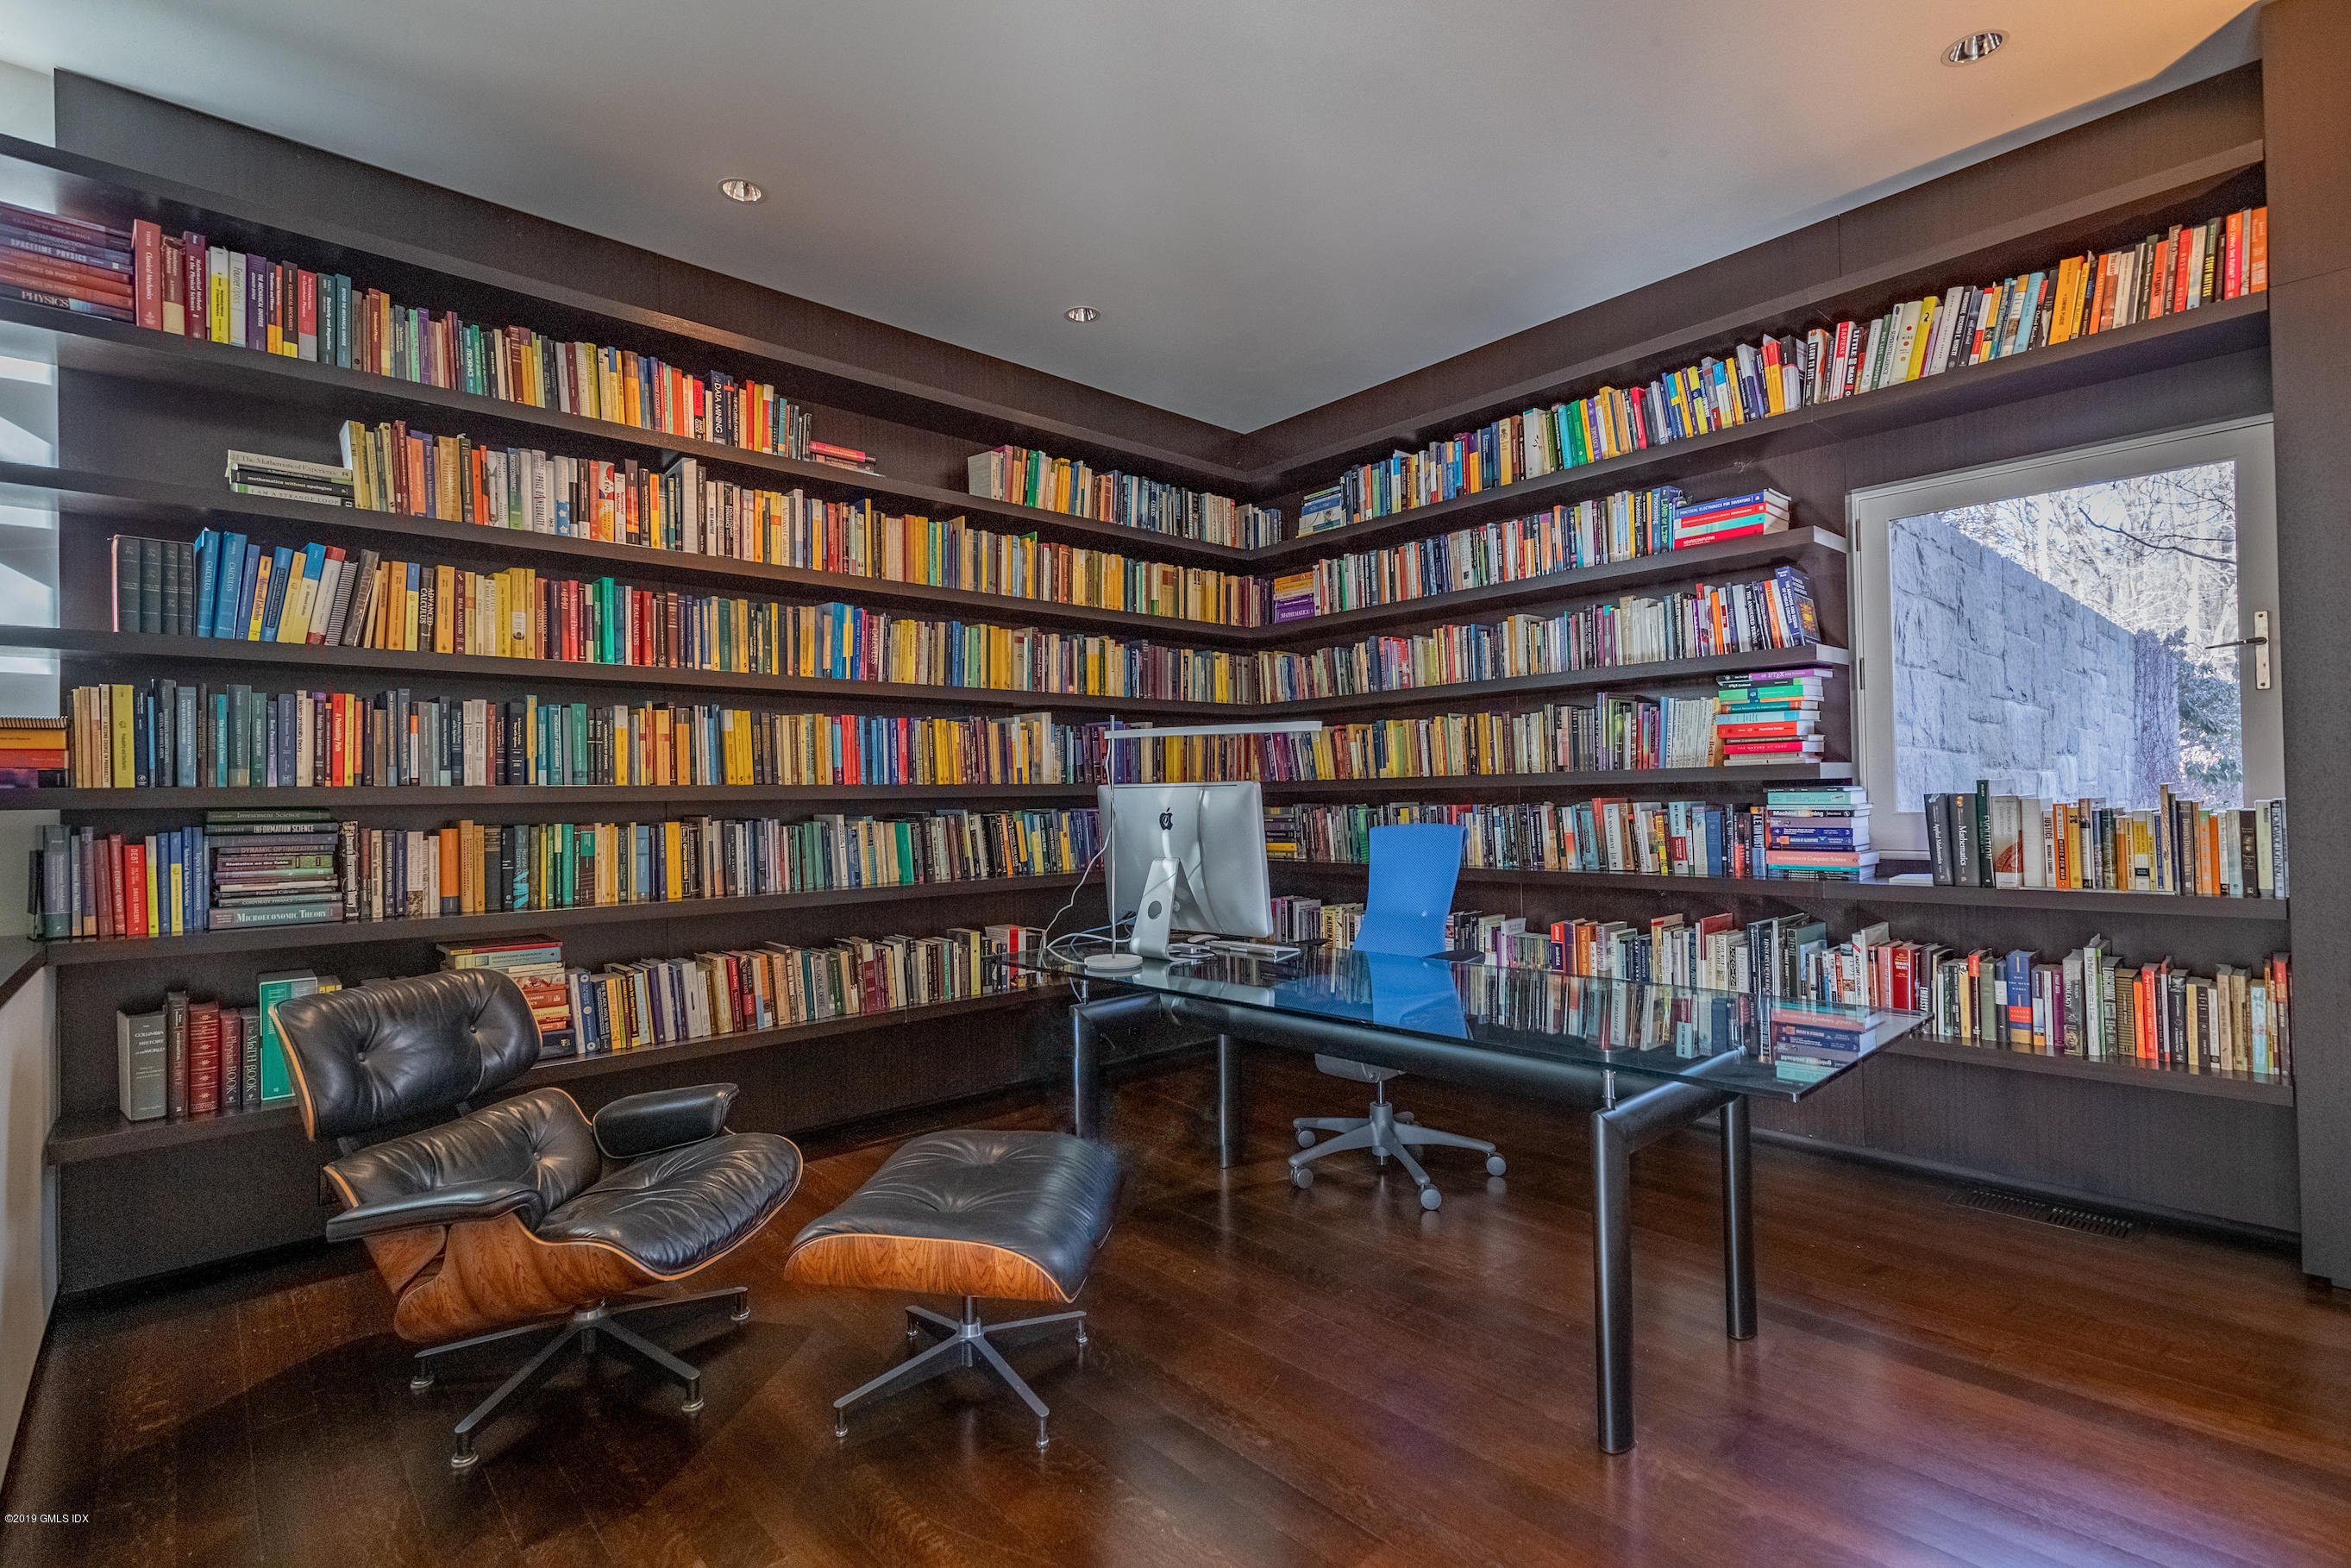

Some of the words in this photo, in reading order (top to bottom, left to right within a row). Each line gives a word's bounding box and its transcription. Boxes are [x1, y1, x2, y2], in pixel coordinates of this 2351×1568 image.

[10, 238, 52, 254] SPACETIME
[56, 248, 87, 263] PHYSICS
[2204, 256, 2215, 273] STUFF
[233, 267, 242, 287] Fourier
[2154, 272, 2163, 297] crypto
[2202, 273, 2214, 297] MATTERS
[22, 290, 69, 308] PHYSICS
[2093, 273, 2104, 313] MASTERMIND
[1850, 329, 1860, 356] LITTLE
[2029, 326, 2038, 343] Murders
[467, 348, 475, 378] MECHANICS
[1883, 329, 1896, 375] SUPERINTELLIGENCE
[1846, 366, 1855, 384] MAN
[1873, 361, 1882, 382] PROSPER
[714, 383, 723, 402] DATA
[714, 404, 723, 433] MINING
[248, 476, 284, 485] mathematics
[307, 484, 333, 492] apologies
[536, 476, 544, 489] PRICE
[279, 493, 314, 503] STRANGE
[1679, 507, 1697, 516] PRACTICAL
[1698, 504, 1722, 513] ELECTRONICS
[1731, 498, 1751, 506] INVENTORS
[534, 497, 545, 526] INEQUALITY
[1683, 535, 1715, 544] NEUROCOMPUTING
[227, 561, 235, 592] CALCULUS
[258, 577, 267, 599] Advanced
[354, 567, 372, 618] CALCULUS
[254, 600, 263, 621] Calculus
[419, 588, 428, 624] CALCULUS
[1281, 608, 1310, 619] MATHEMATICA
[871, 628, 880, 665] CALCULUS
[1983, 815, 1992, 859] EVOLUTION
[2044, 817, 2053, 840] JUSTICE
[2272, 812, 2282, 847] HOMEMADE
[130, 849, 140, 863] DEBT
[1958, 825, 1968, 866] Mathematics
[2273, 847, 2283, 878] LIGHTNING
[236, 913, 298, 923] MICROECONOMIC
[299, 909, 326, 919] THEORY
[2065, 964, 2073, 1008] SOCIOBIOLOGY
[2103, 967, 2116, 1000] LOGICOMIX
